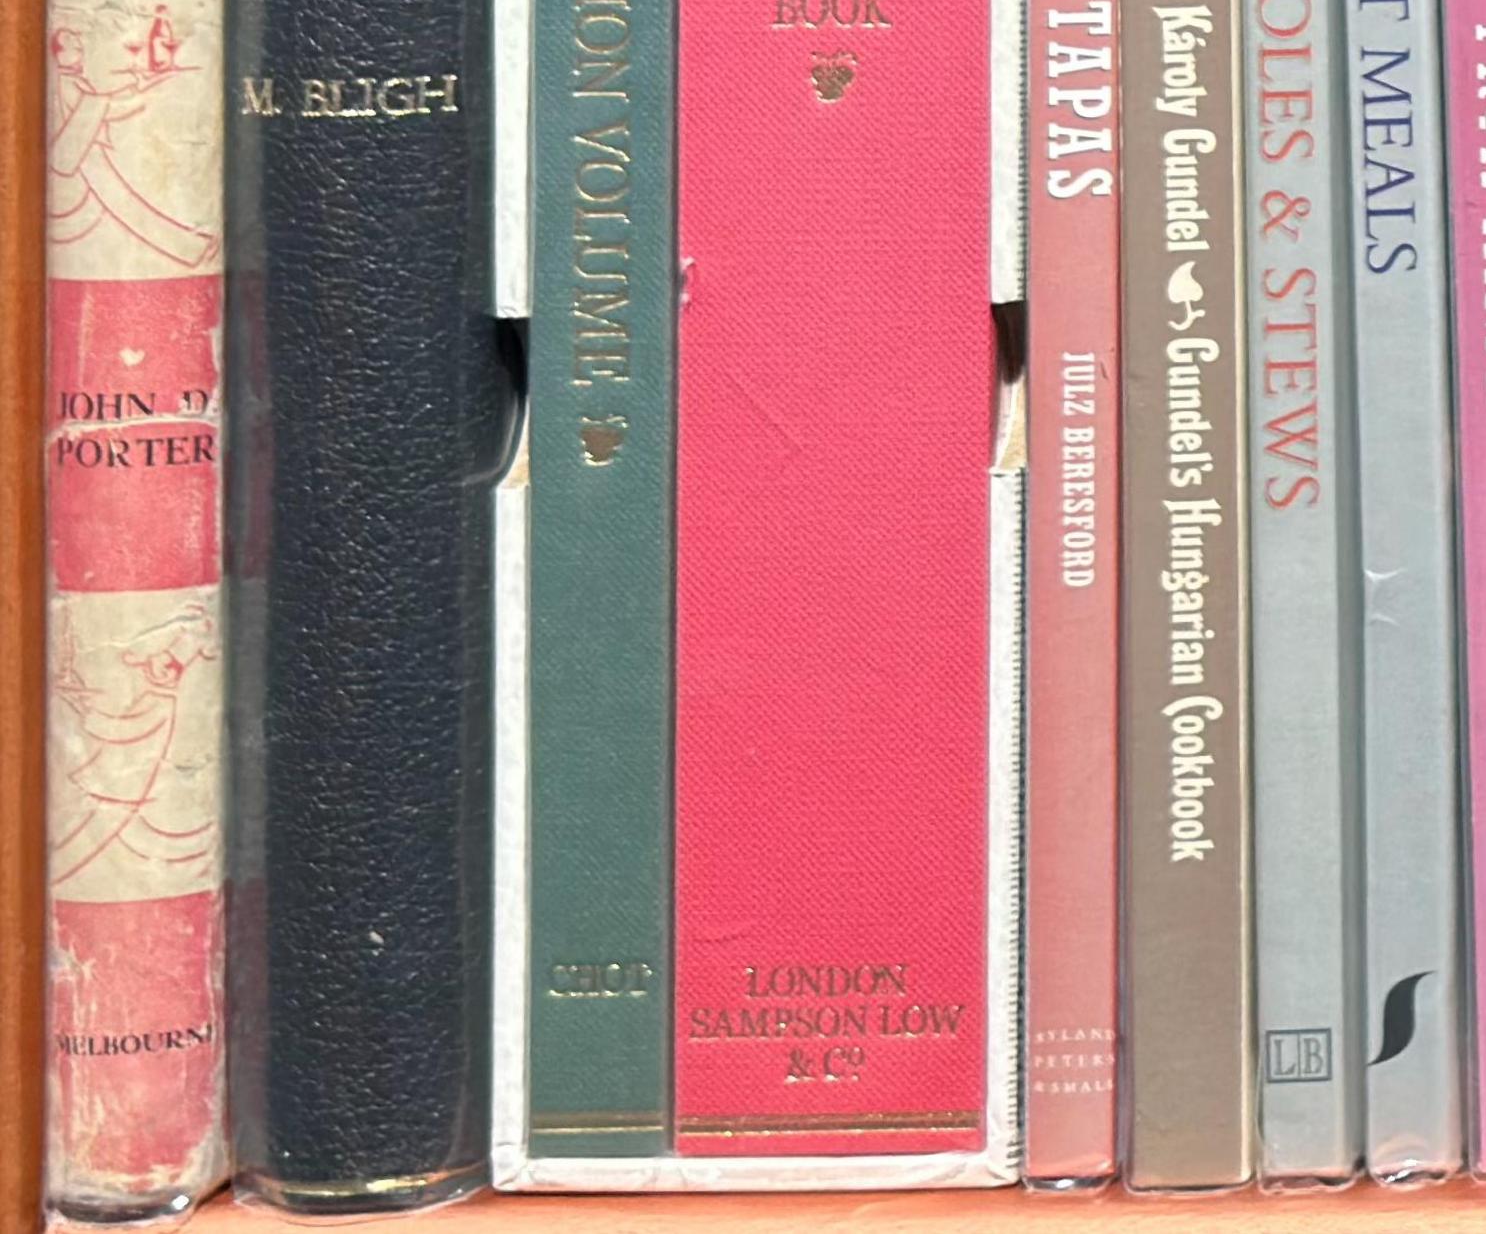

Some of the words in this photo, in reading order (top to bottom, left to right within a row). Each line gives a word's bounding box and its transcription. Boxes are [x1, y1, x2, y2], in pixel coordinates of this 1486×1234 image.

[241, 77, 279, 117] M.
[302, 75, 458, 115] BLIGH
[1045, 3, 1113, 201] TAPAS
[1153, 5, 1211, 122] Károly
[1163, 127, 1216, 253] Gundel
[1260, 190, 1315, 241] &
[1358, 47, 1418, 275] MEALS
[571, 118, 632, 388] VOLUME
[61, 391, 155, 421] JOHN
[1062, 351, 1095, 416] JULZ
[1169, 335, 1220, 489] Gundel's
[1261, 266, 1322, 512] STEWS
[57, 434, 214, 467] PORTER
[1062, 424, 1095, 589] BERESFORD
[1162, 498, 1223, 687] Hungarian
[1161, 697, 1223, 863] Cookbook
[689, 1005, 868, 1040] SAMPSON
[880, 1005, 963, 1038] LOW
[745, 965, 907, 997] LONDON
[784, 1048, 816, 1083] &
